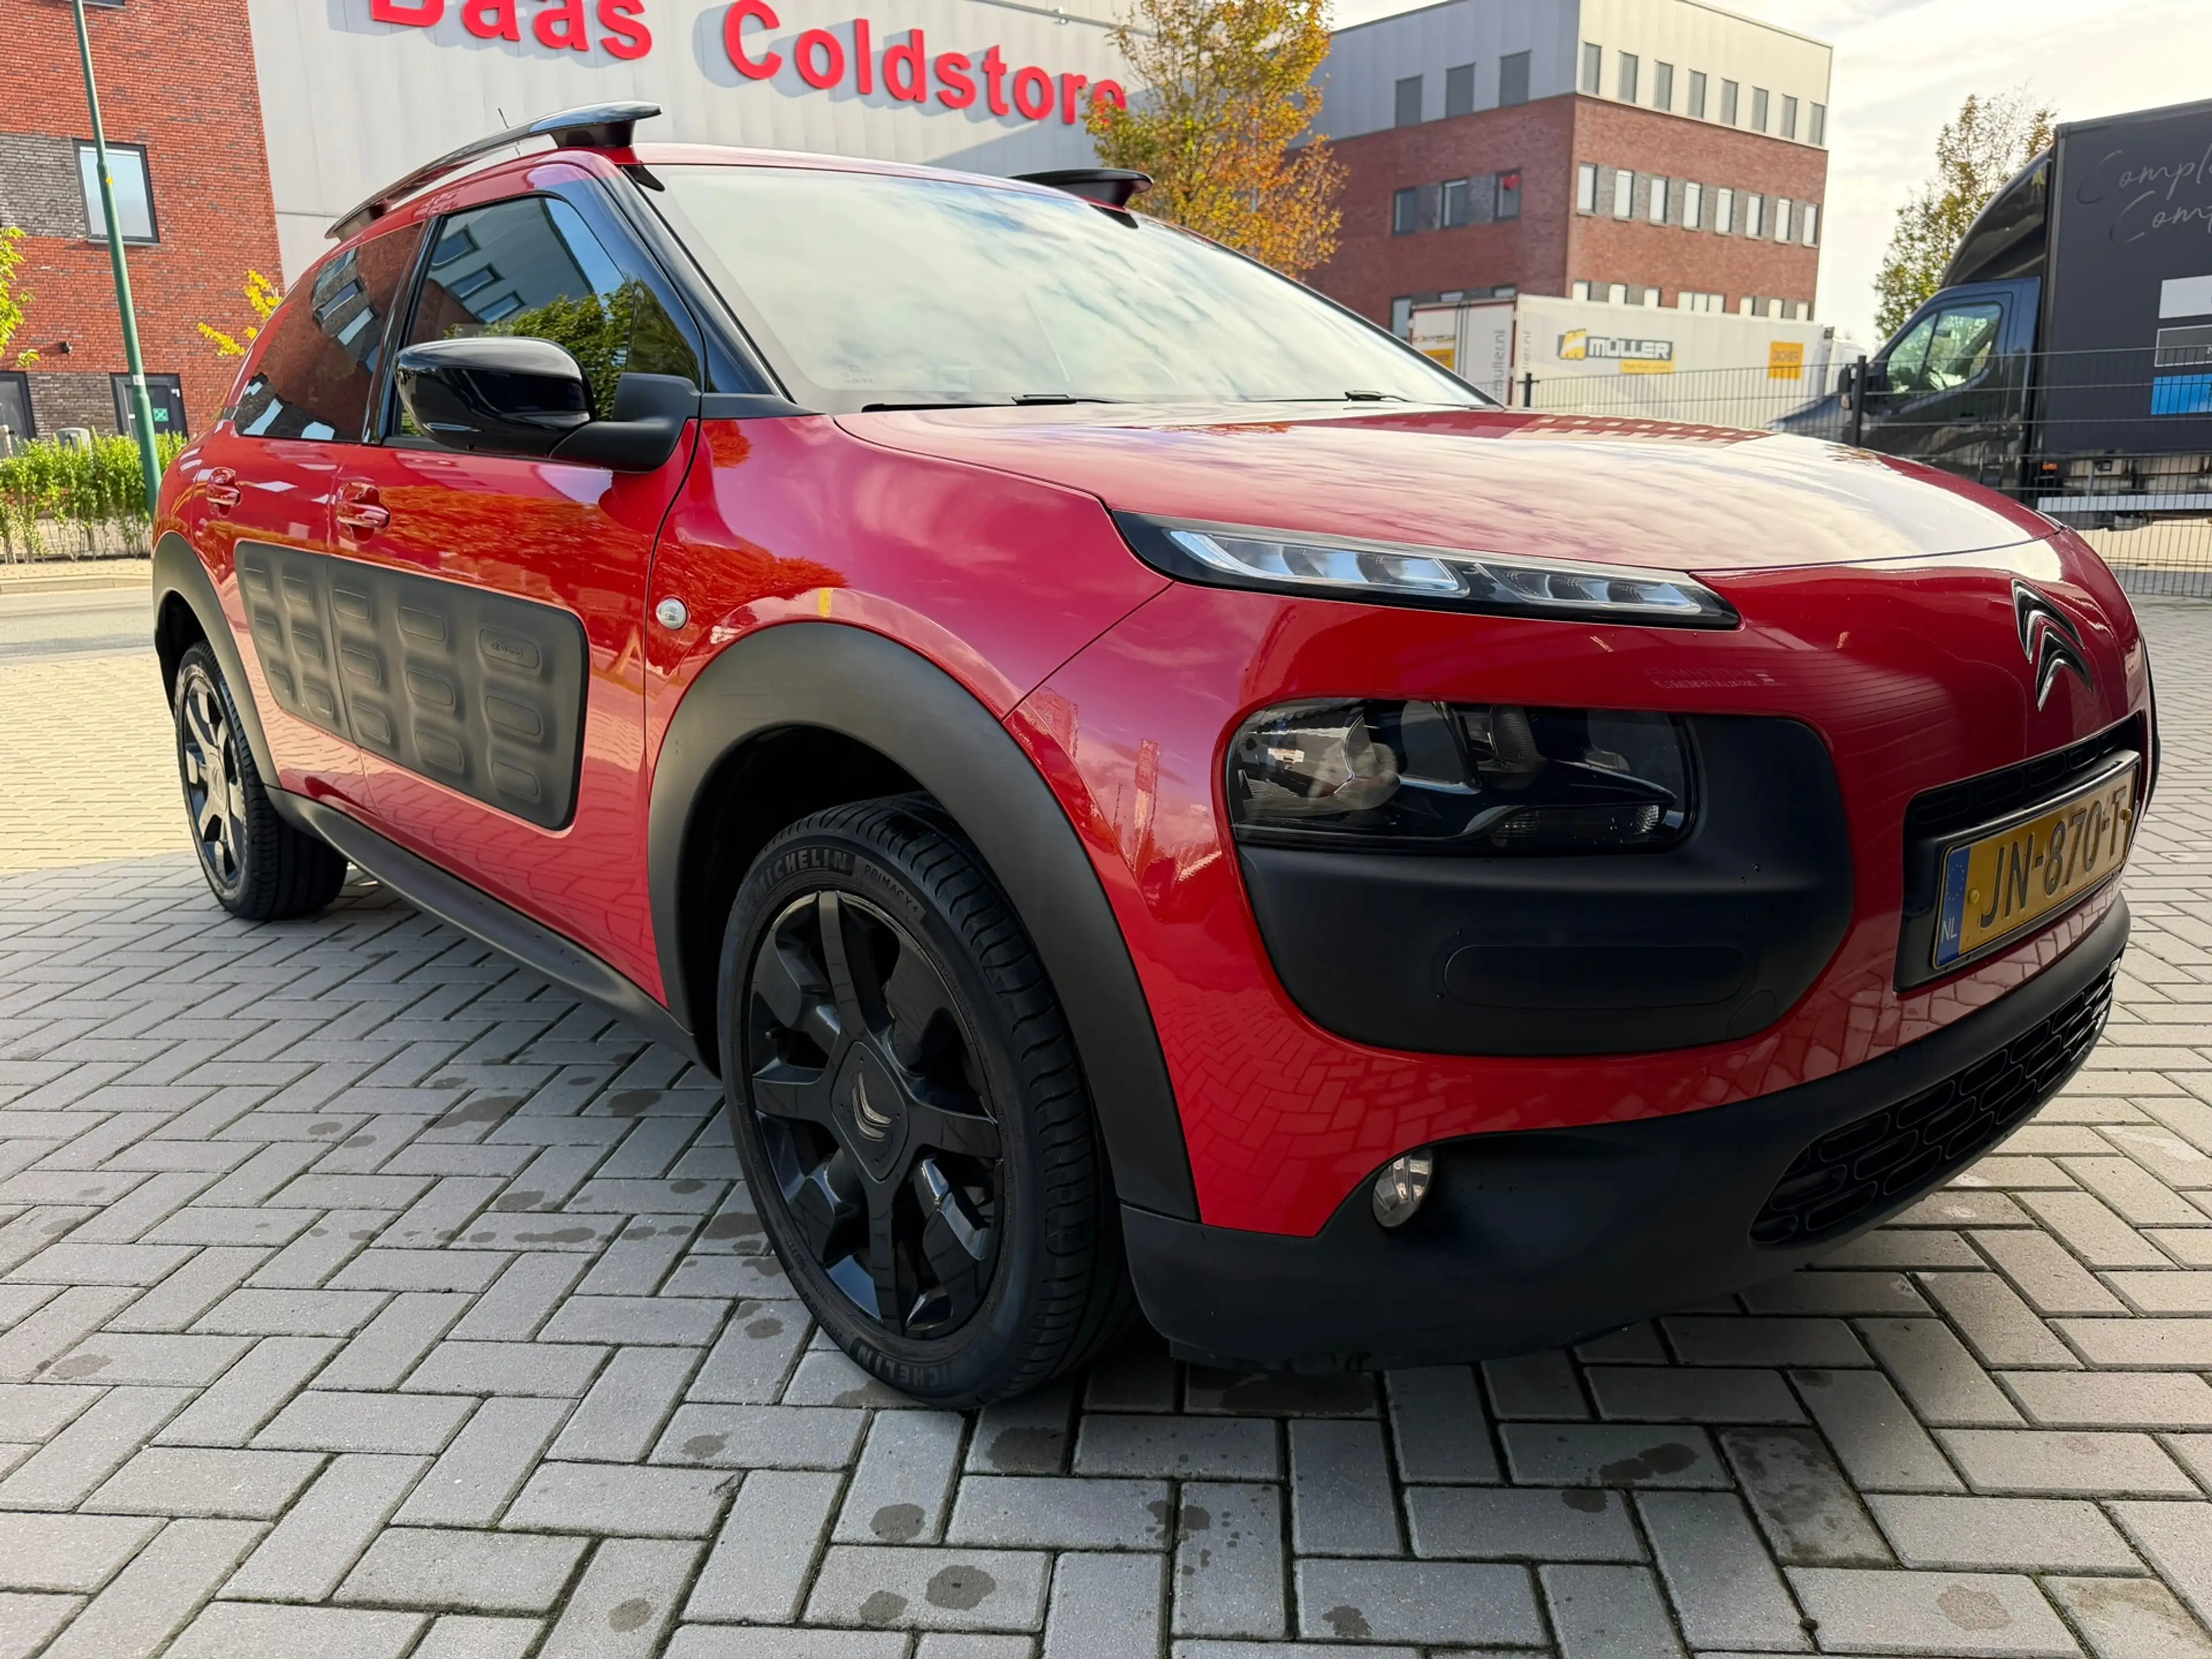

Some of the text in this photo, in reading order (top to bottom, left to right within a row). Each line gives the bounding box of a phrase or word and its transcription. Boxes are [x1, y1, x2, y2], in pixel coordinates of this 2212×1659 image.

[2076, 143, 2212, 204] Compl
[2108, 191, 2212, 243] Com
[752, 847, 849, 896] MICHELIN
[1980, 785, 2128, 929] JN-870-T
[864, 863, 912, 906] PRIMACY
[1940, 915, 1957, 944] NL
